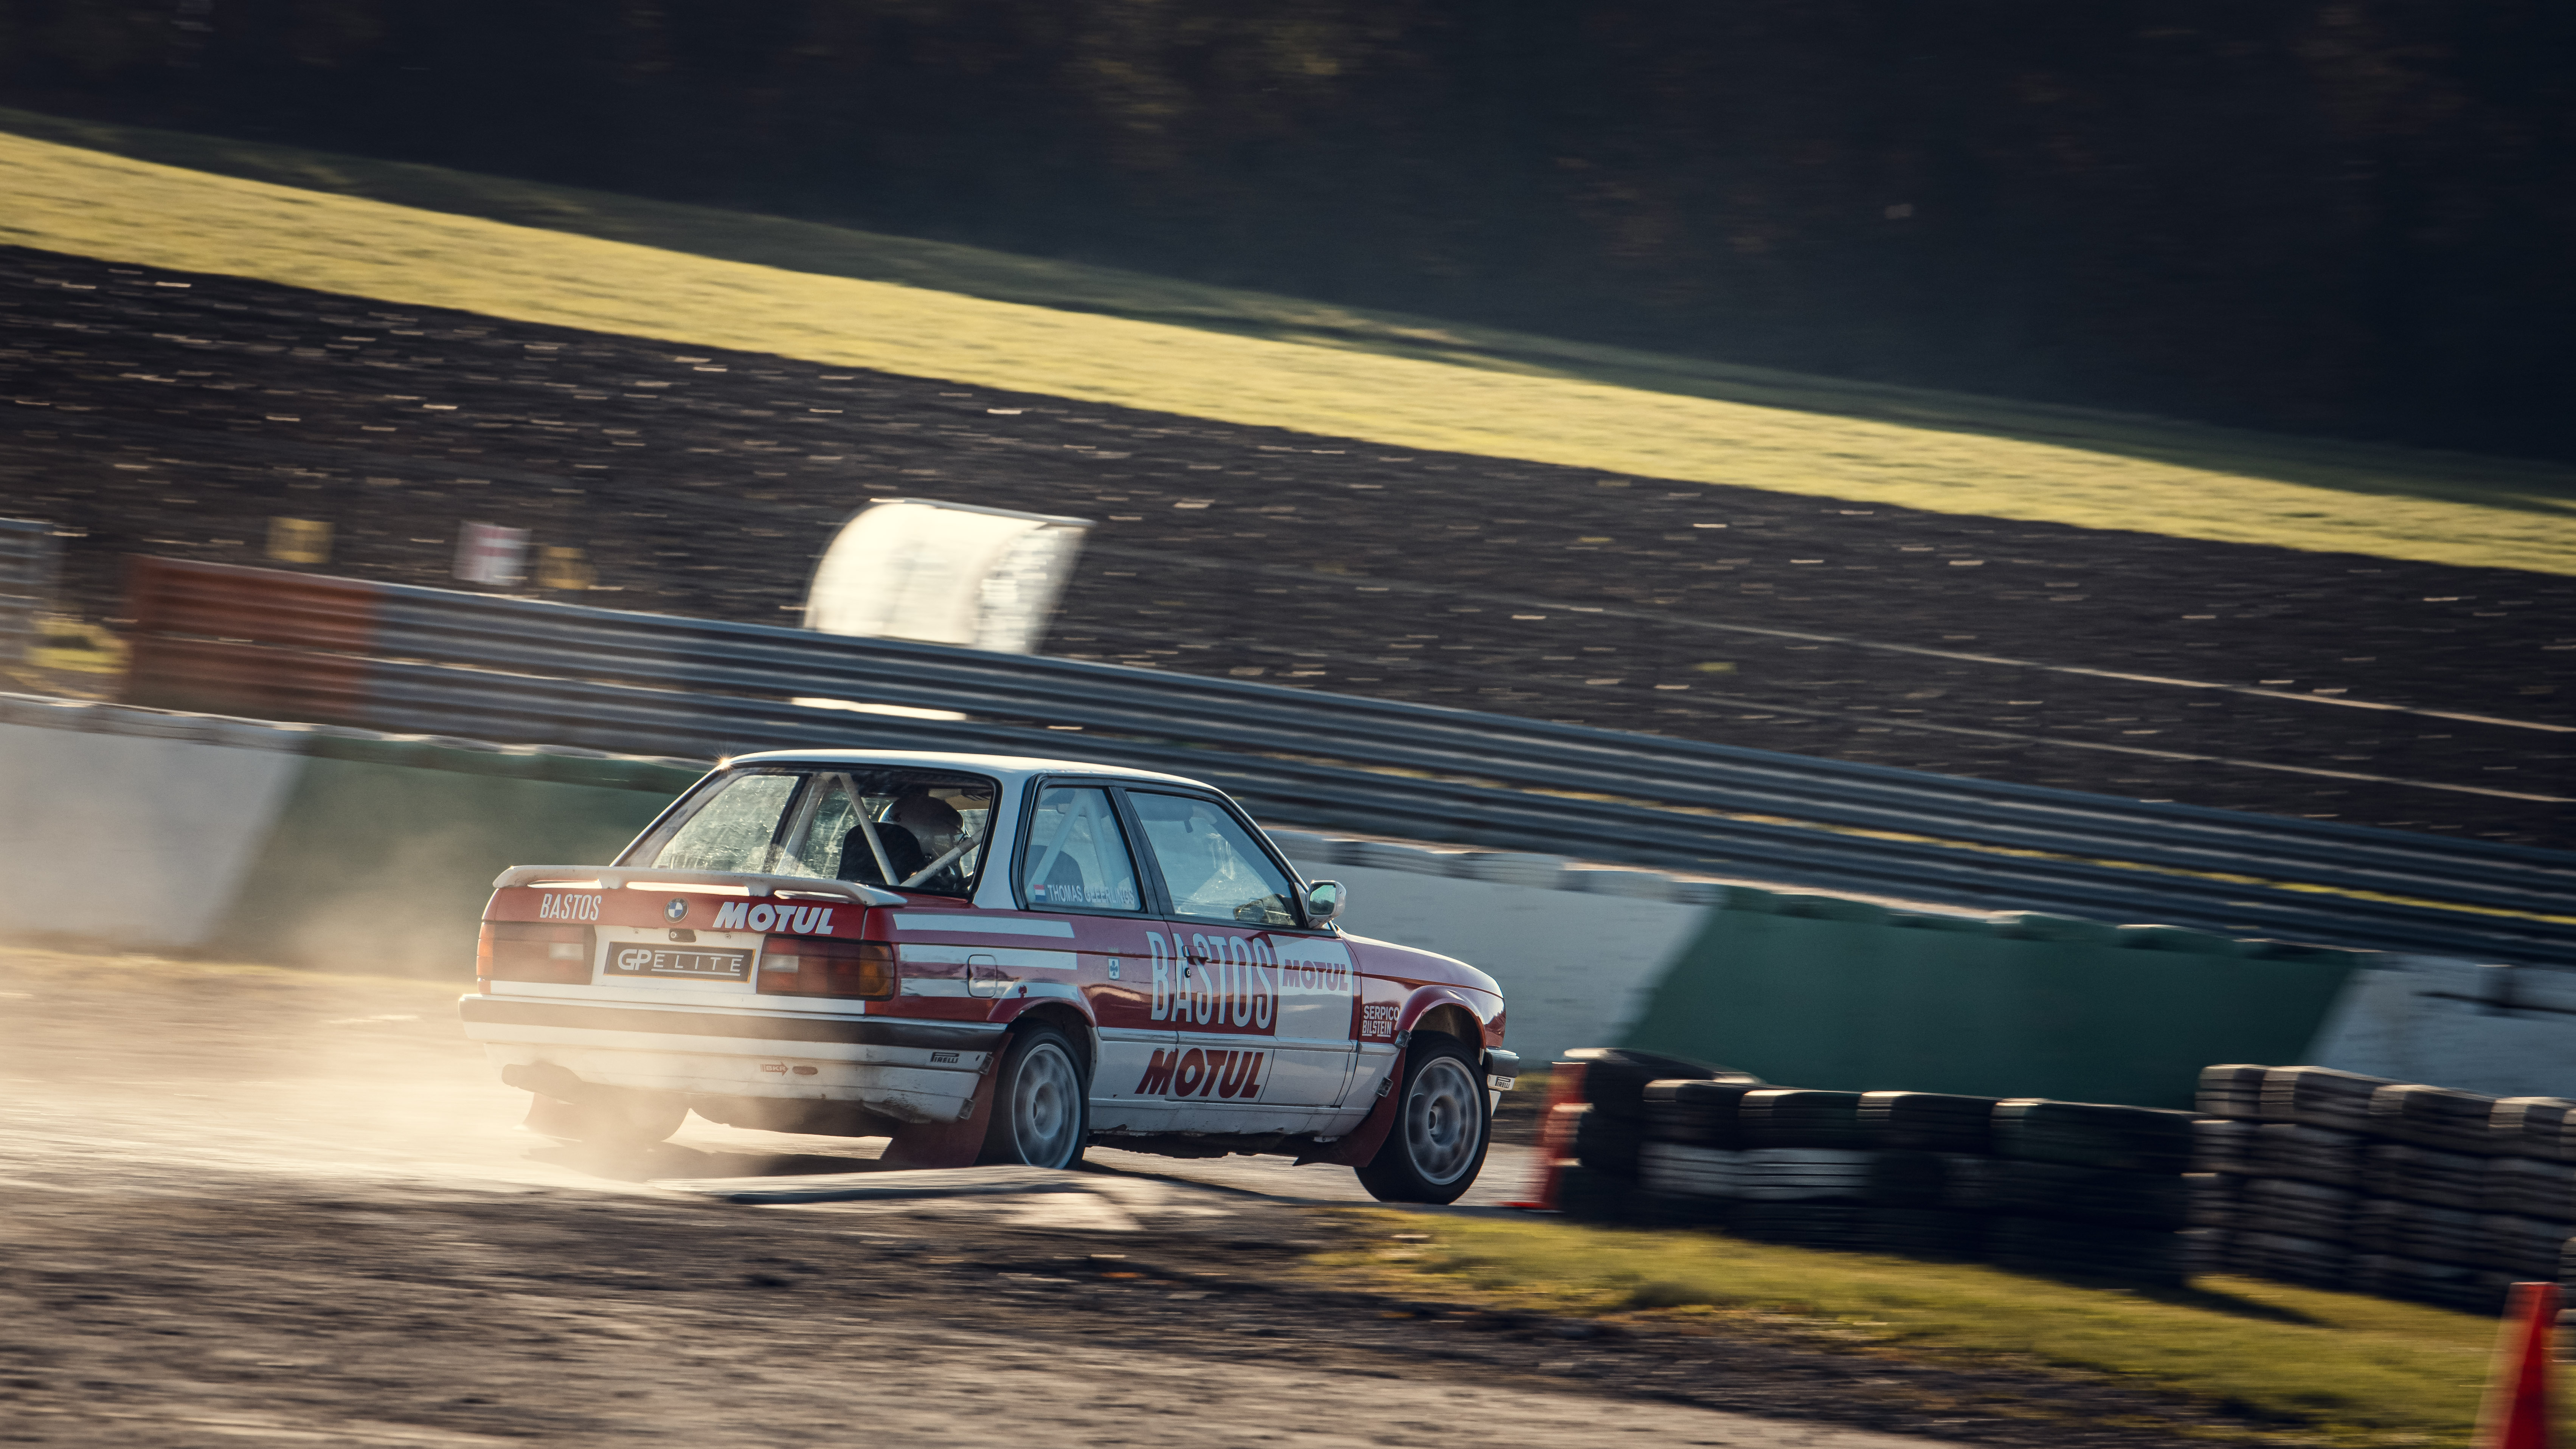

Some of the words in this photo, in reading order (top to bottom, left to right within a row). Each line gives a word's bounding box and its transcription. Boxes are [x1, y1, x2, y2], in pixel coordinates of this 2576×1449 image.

[1047, 884, 1083, 902] THOMAS
[540, 893, 602, 921] BASTOS
[712, 901, 834, 935] MOTUL
[1146, 931, 1273, 1029] BASTOS
[1282, 959, 1349, 991] MOTUL
[1364, 1005, 1400, 1021] SERPICO
[1362, 1020, 1392, 1035] BILSTEIN
[930, 1051, 960, 1064] PIRELLI
[1134, 1047, 1265, 1098] MOTUL
[1494, 1076, 1511, 1089] PIRELLI
